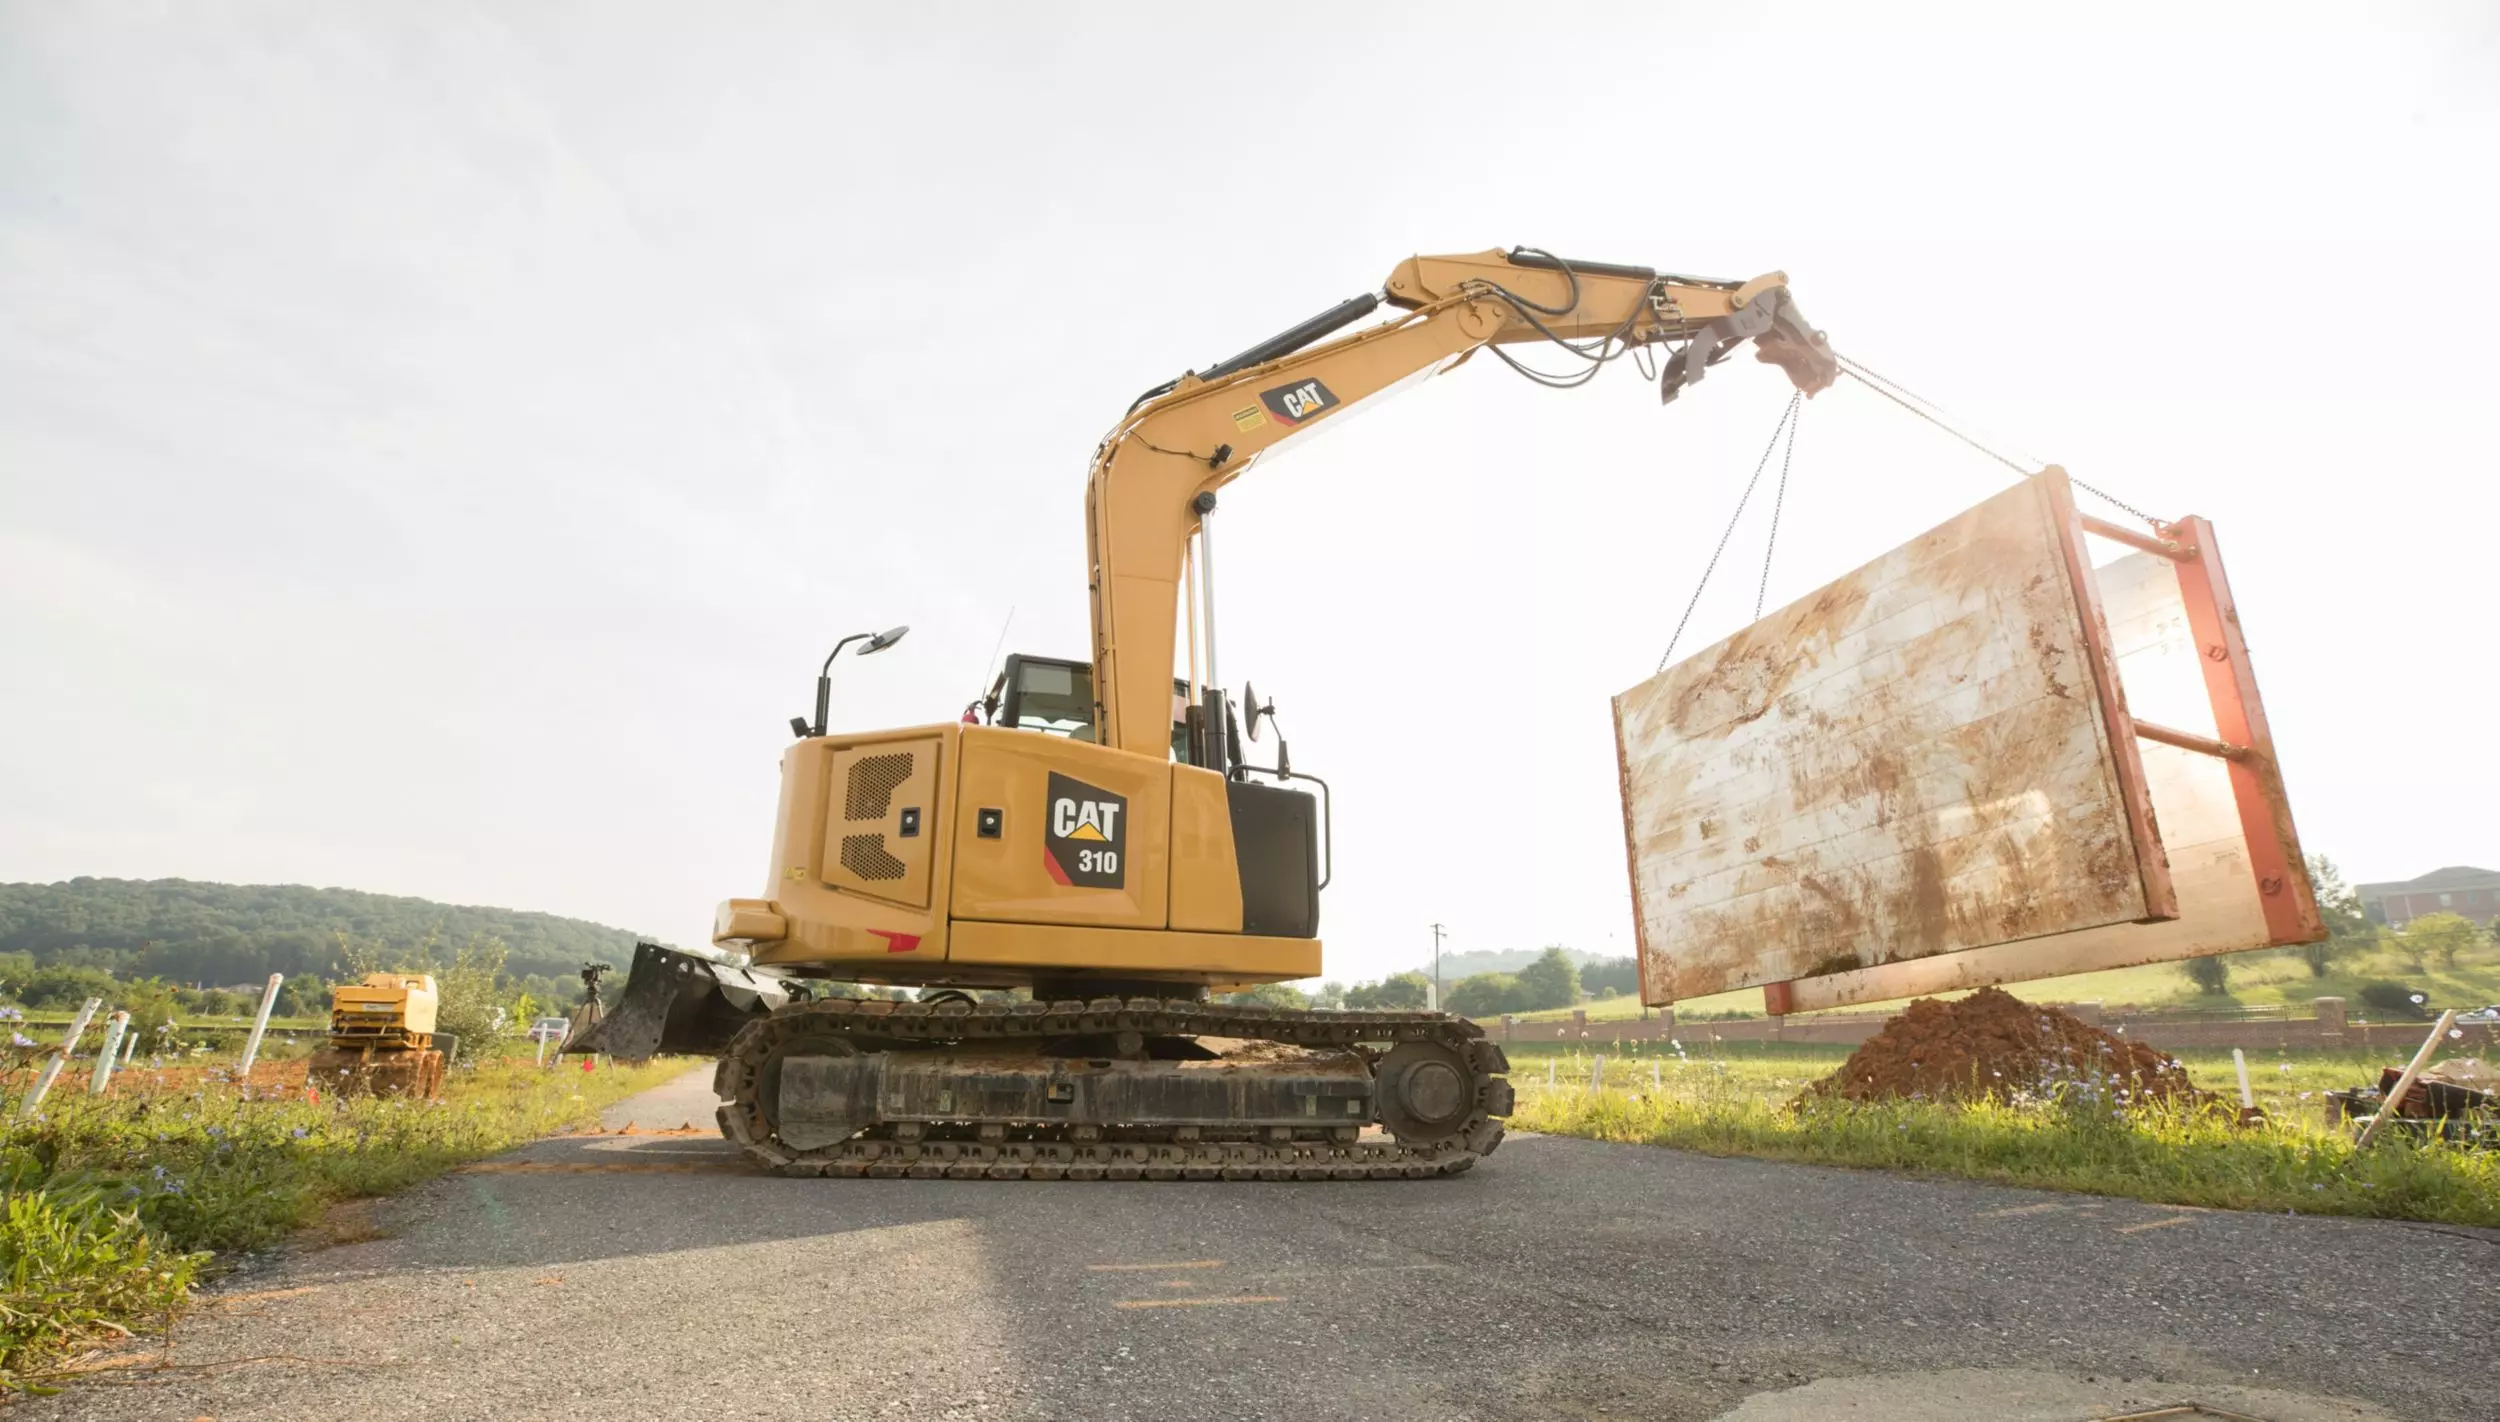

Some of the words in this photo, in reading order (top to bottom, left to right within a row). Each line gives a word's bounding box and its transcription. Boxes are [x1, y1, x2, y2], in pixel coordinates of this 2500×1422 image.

[1283, 383, 1324, 418] CAT
[1054, 798, 1119, 842] CAT
[1078, 850, 1117, 874] 310
